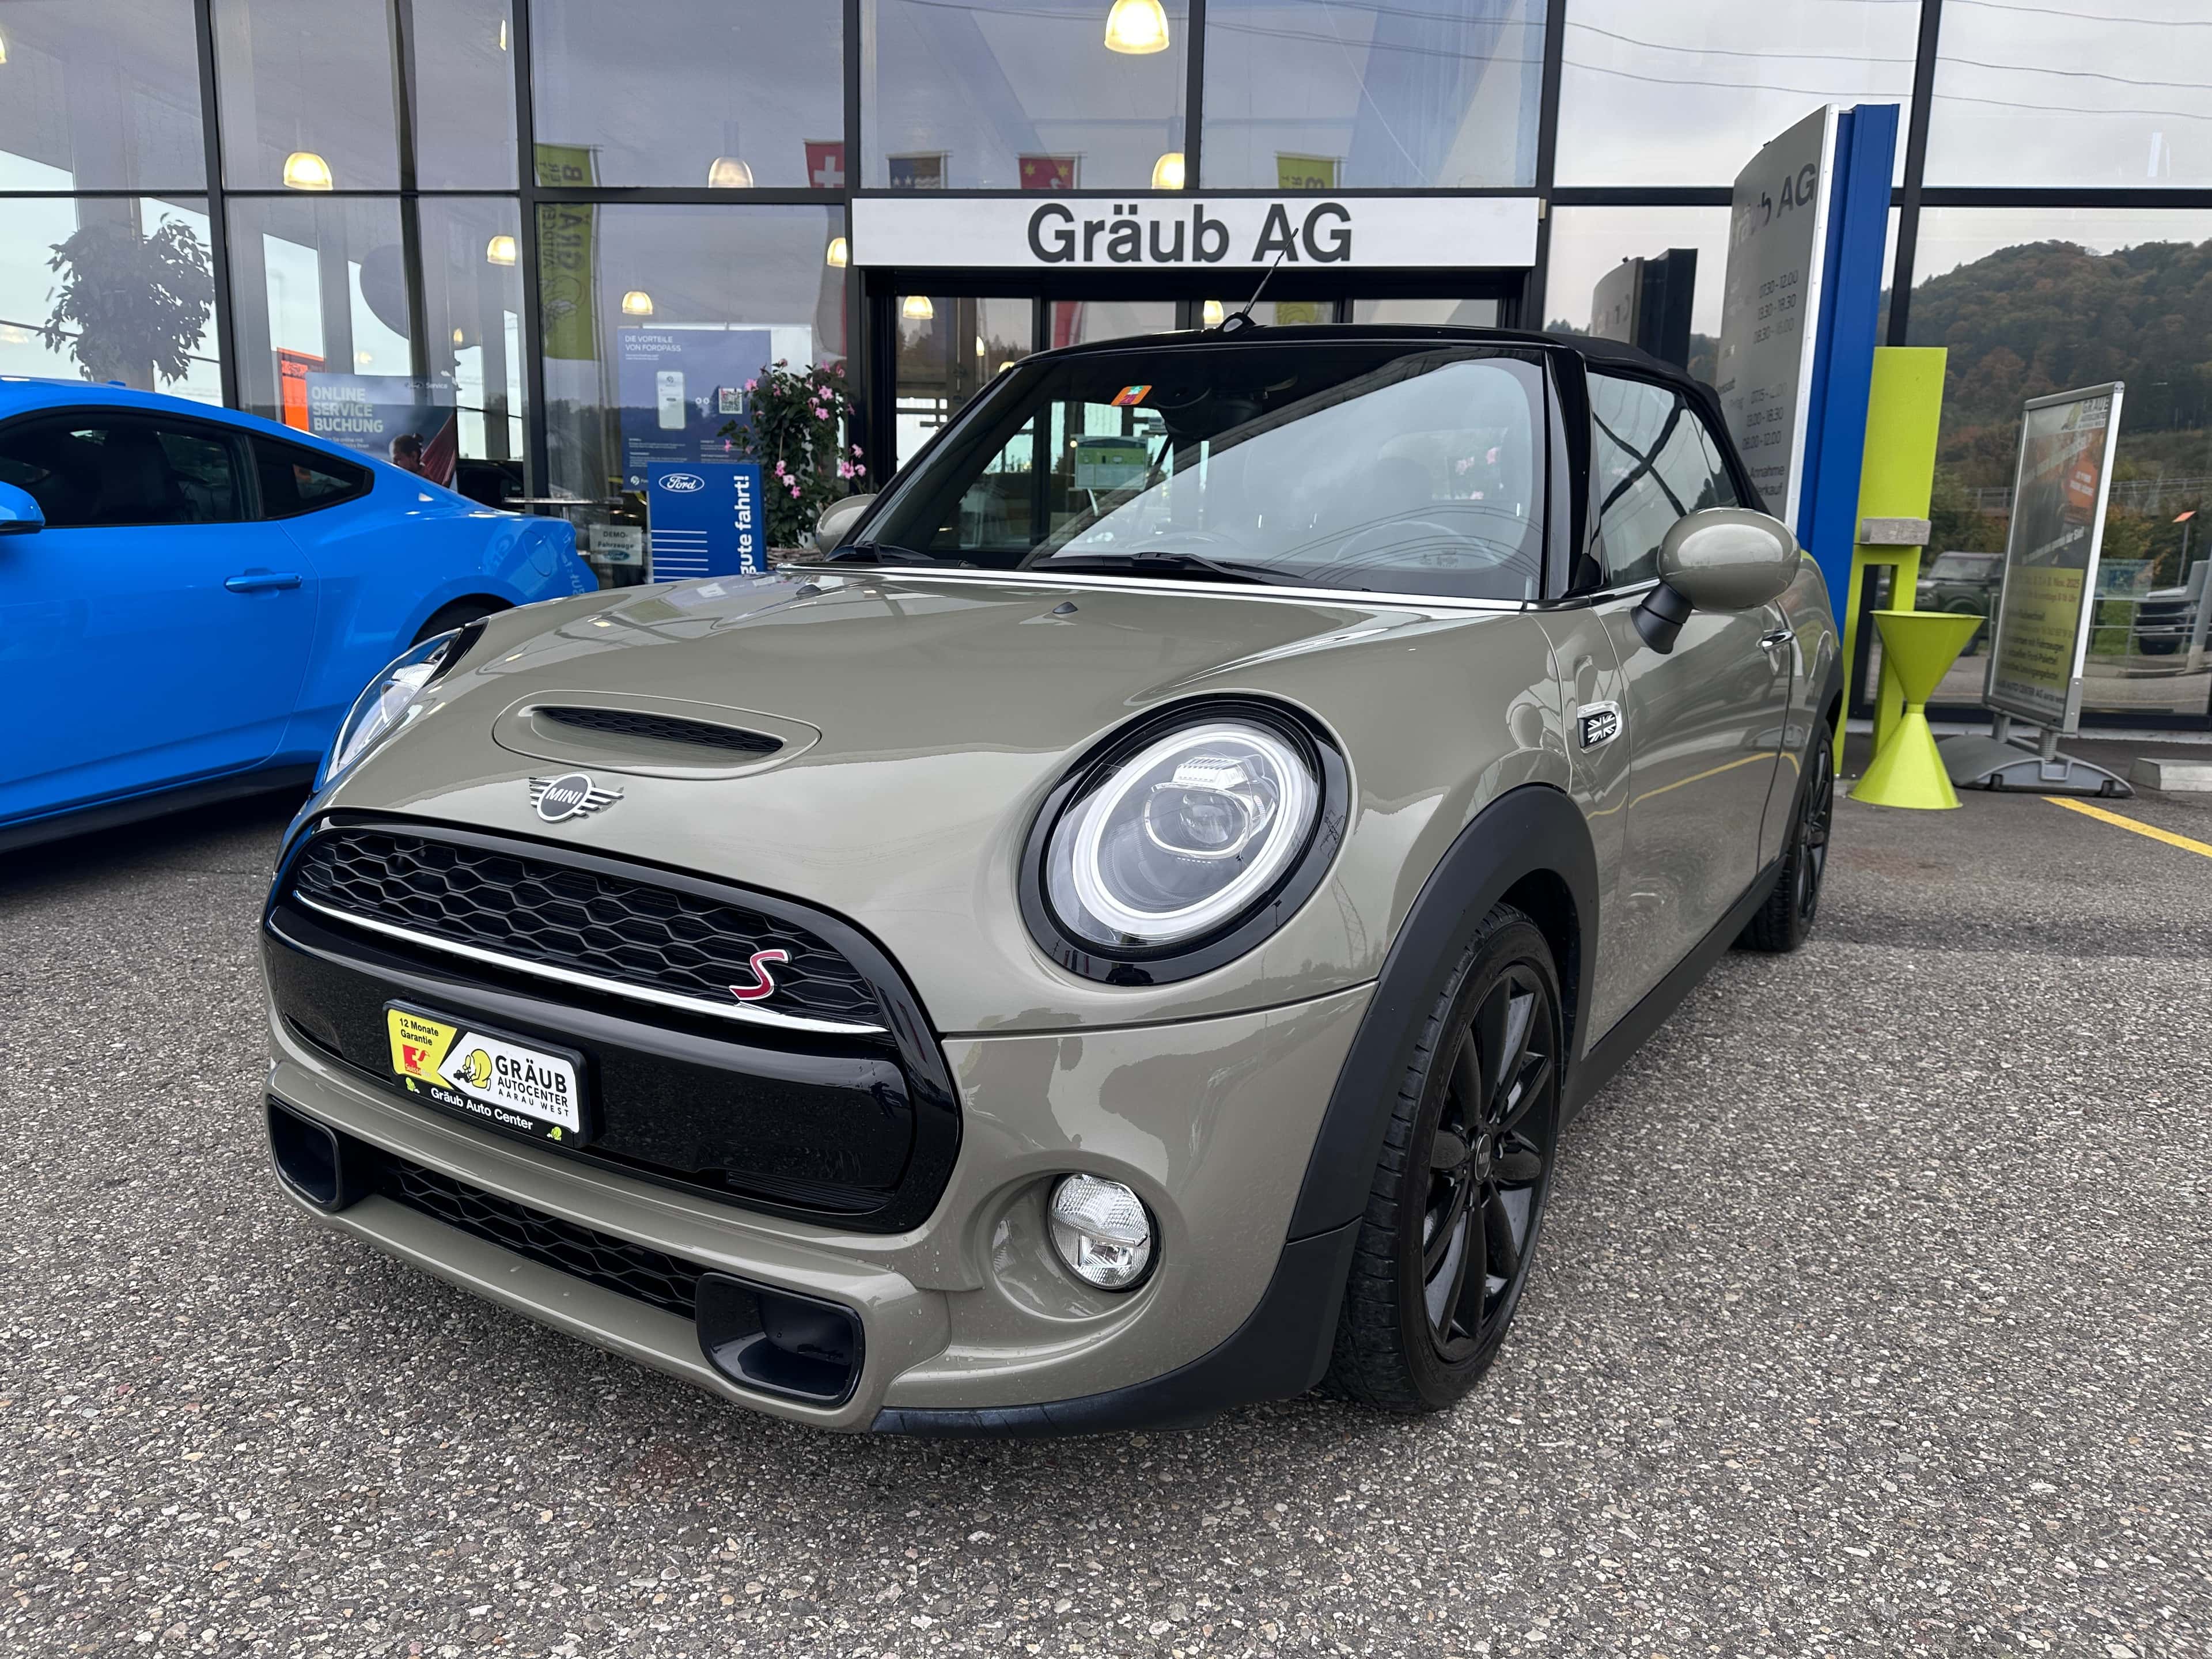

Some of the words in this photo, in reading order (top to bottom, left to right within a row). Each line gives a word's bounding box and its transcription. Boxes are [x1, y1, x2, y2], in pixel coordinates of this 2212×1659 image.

[1777, 163, 1816, 218] AG
[1028, 202, 1230, 264] Gräub
[1252, 202, 1352, 264] AG
[638, 335, 673, 343] VORTEILE
[642, 344, 681, 352] FORDPASS
[312, 387, 366, 402] ONLINE
[313, 403, 373, 418] SERVICE
[314, 418, 383, 433] BUCHUNG
[1751, 465, 1785, 479] Annahme
[665, 475, 698, 490] Ford
[1757, 482, 1783, 496] erkauf
[734, 475, 752, 532] fahrt!
[598, 541, 634, 550] Fahrzeuge
[737, 534, 756, 575] gute
[545, 787, 583, 805] MINI
[728, 949, 789, 1001] S
[400, 1018, 409, 1028] 12
[410, 1020, 439, 1036] Monate
[400, 1029, 433, 1046] Garantie
[495, 1055, 567, 1093] GRÄUB
[498, 1076, 569, 1107] AUTOCENTER
[430, 1087, 464, 1107] Gräub
[466, 1099, 492, 1116] Auto
[494, 1108, 533, 1130] Center
[498, 1088, 534, 1106] AARAU
[540, 1101, 569, 1118] WEST
